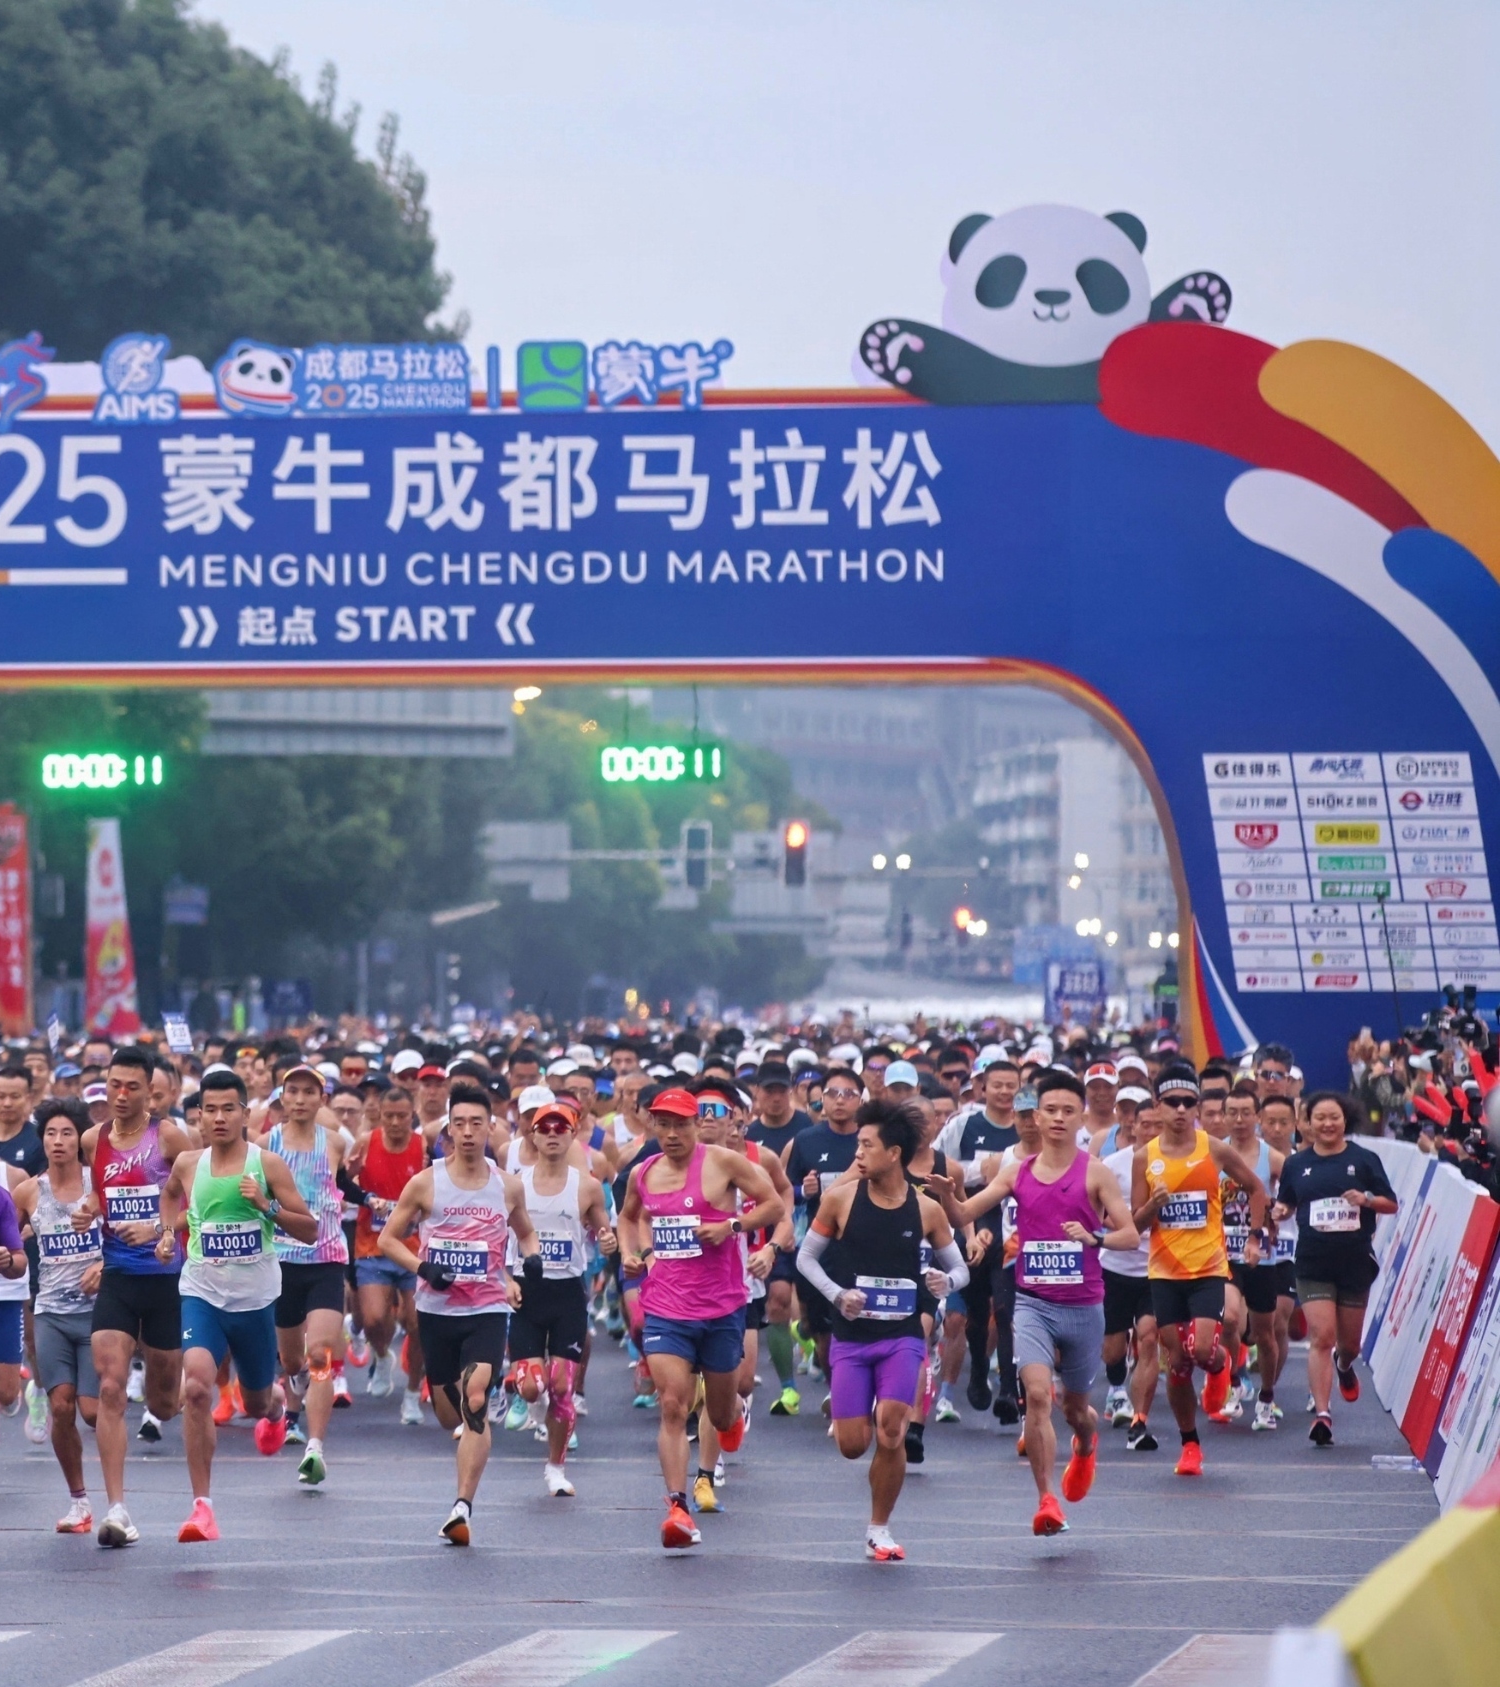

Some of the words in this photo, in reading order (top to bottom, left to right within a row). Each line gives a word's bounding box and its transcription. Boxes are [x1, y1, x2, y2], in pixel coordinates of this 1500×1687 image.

[305, 349, 466, 380] 成都马拉松
[597, 344, 718, 406] 蒙牛
[305, 384, 380, 410] 2025
[382, 383, 467, 394] CHENGDU
[382, 395, 467, 408] MARATHON
[99, 393, 177, 421] AIMS
[159, 428, 943, 534] 蒙牛成都马拉松
[159, 553, 387, 588] MENGNIU
[406, 551, 647, 585] CHENGDU
[667, 549, 944, 584] MARATHON
[238, 606, 317, 647] 起点
[334, 605, 476, 643] START
[1232, 761, 1283, 777] 佳得乐
[103, 1143, 154, 1182] BMAI
[111, 1198, 155, 1214] A10021
[443, 1206, 493, 1219] saucony
[1161, 1203, 1202, 1218] A10431
[1315, 1211, 1358, 1223] 警察护跑
[225, 1223, 242, 1232] 蒙牛
[48, 1231, 94, 1250] A10012
[207, 1234, 256, 1250] A10010
[655, 1228, 694, 1244] A10144
[453, 1241, 469, 1250] 蒙牛
[433, 1251, 481, 1267] A10034
[1029, 1254, 1076, 1269] A10016
